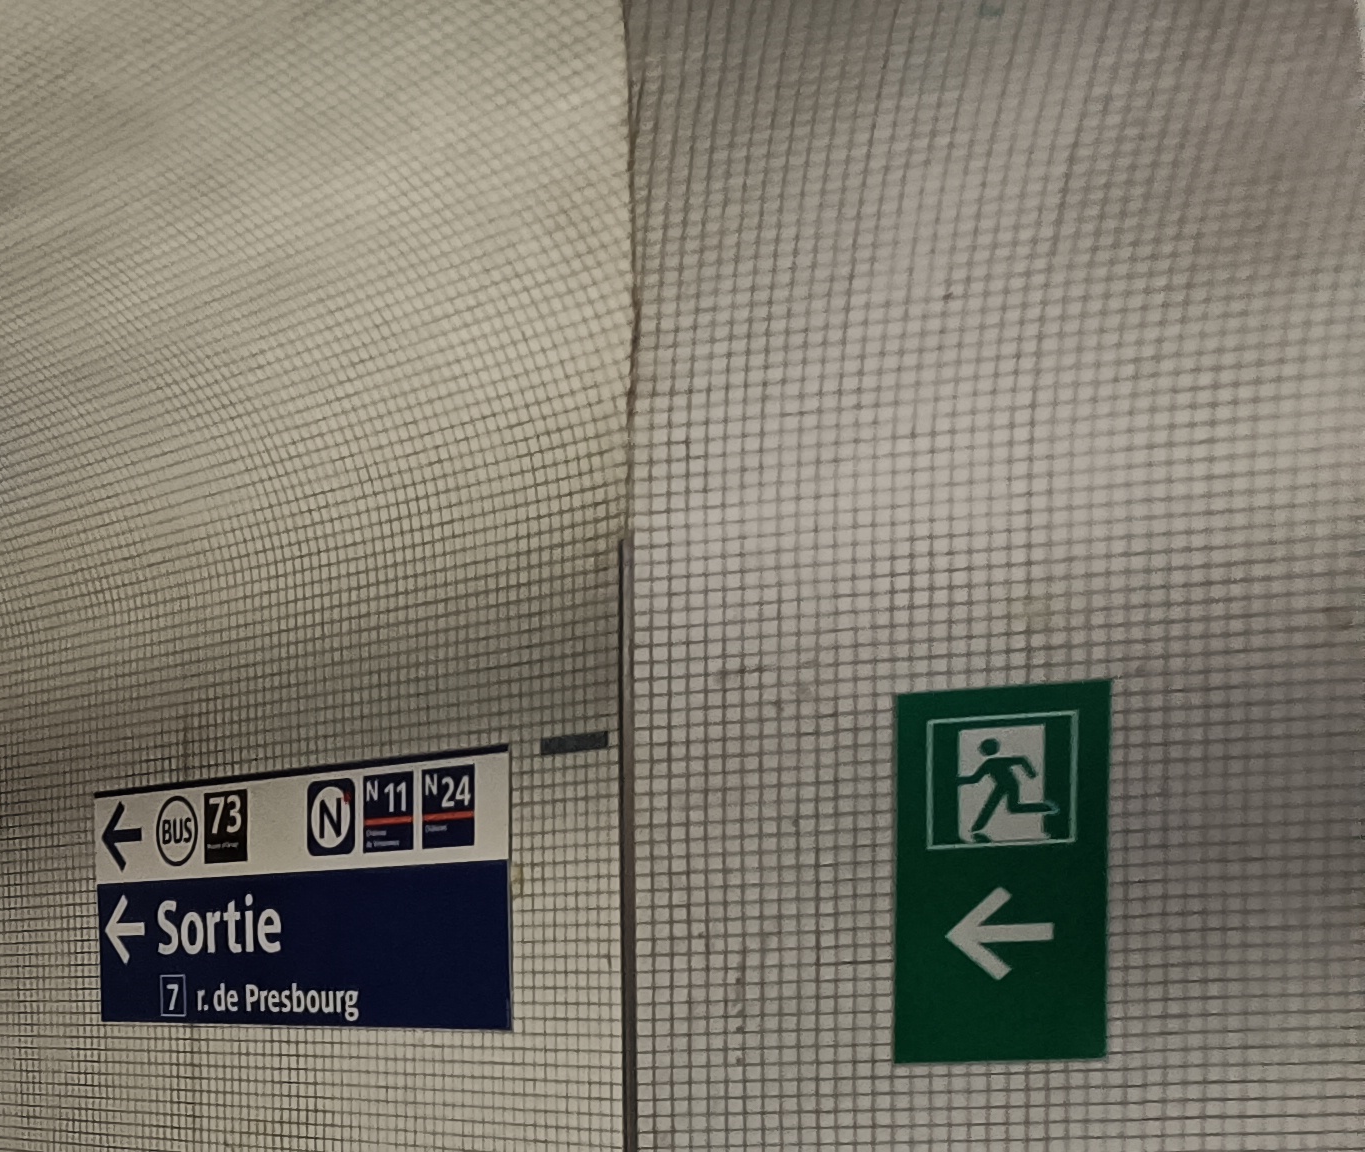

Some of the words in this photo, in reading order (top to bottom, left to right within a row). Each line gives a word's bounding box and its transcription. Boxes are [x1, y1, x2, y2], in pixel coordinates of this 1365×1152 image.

[162, 817, 193, 845] BUS
[209, 794, 242, 835] 73
[319, 797, 342, 839] N
[157, 893, 282, 955] Sortie
[166, 983, 179, 1011] 7
[197, 989, 209, 1012] r.
[213, 982, 239, 1012] de
[245, 982, 359, 1022] Presbourg
